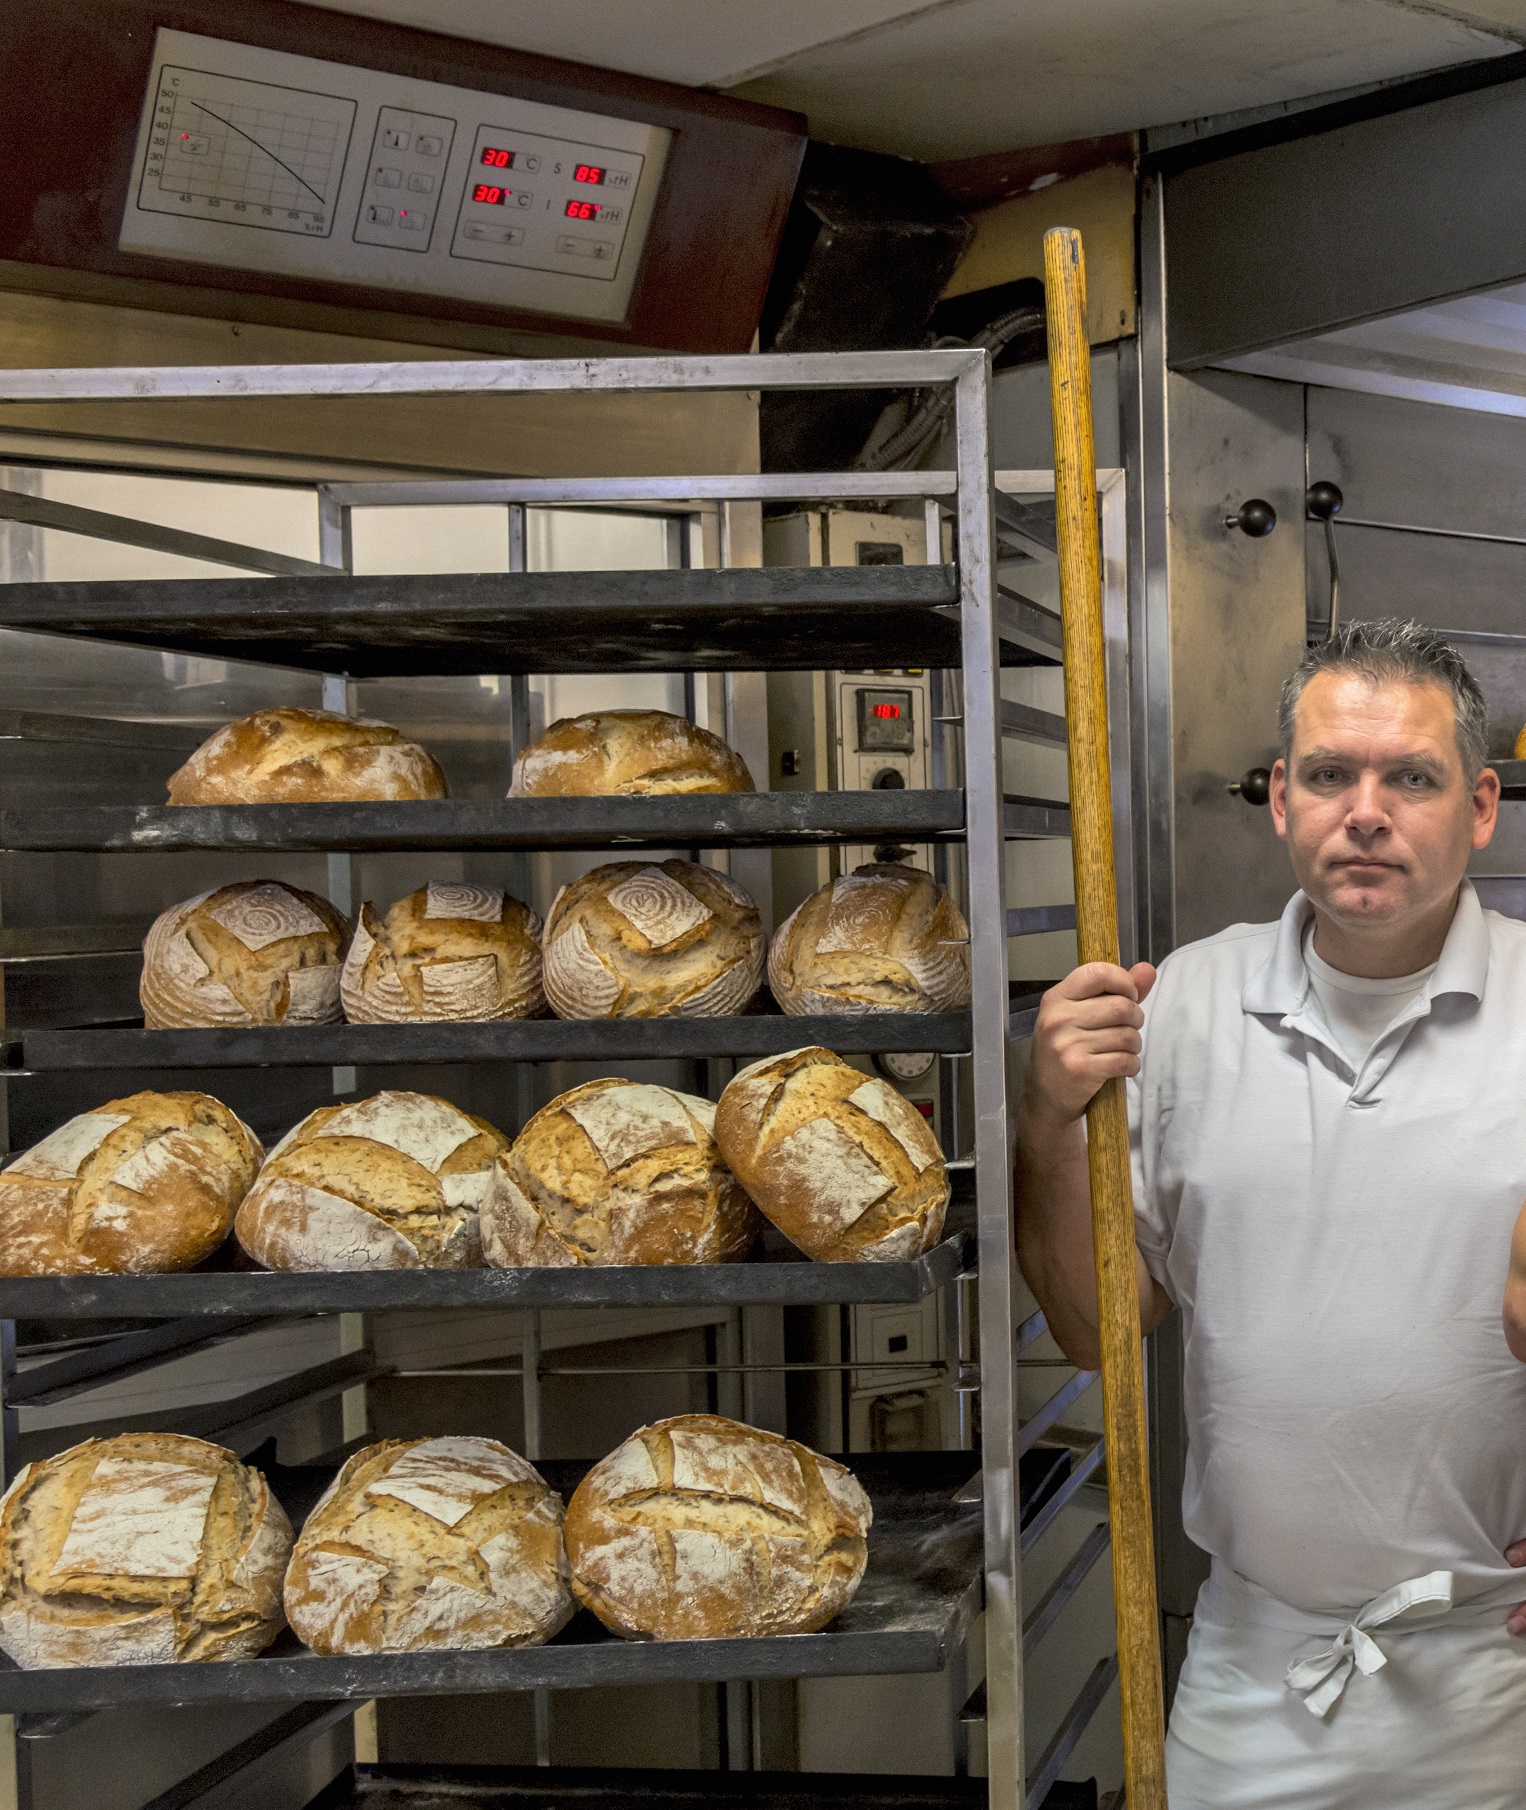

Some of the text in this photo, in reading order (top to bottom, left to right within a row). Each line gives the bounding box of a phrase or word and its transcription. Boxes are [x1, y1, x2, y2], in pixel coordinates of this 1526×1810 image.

[162, 90, 175, 98] 50
[158, 106, 172, 114] 45
[155, 122, 169, 130] 40
[152, 137, 166, 146] 35
[149, 152, 163, 161] 30
[483, 150, 509, 167] 30
[148, 168, 160, 177] 25
[575, 166, 600, 184] 85
[474, 185, 500, 204] 30
[179, 194, 192, 203] 45
[208, 199, 221, 208] 55
[234, 202, 247, 212] 65
[567, 201, 591, 219] 66
